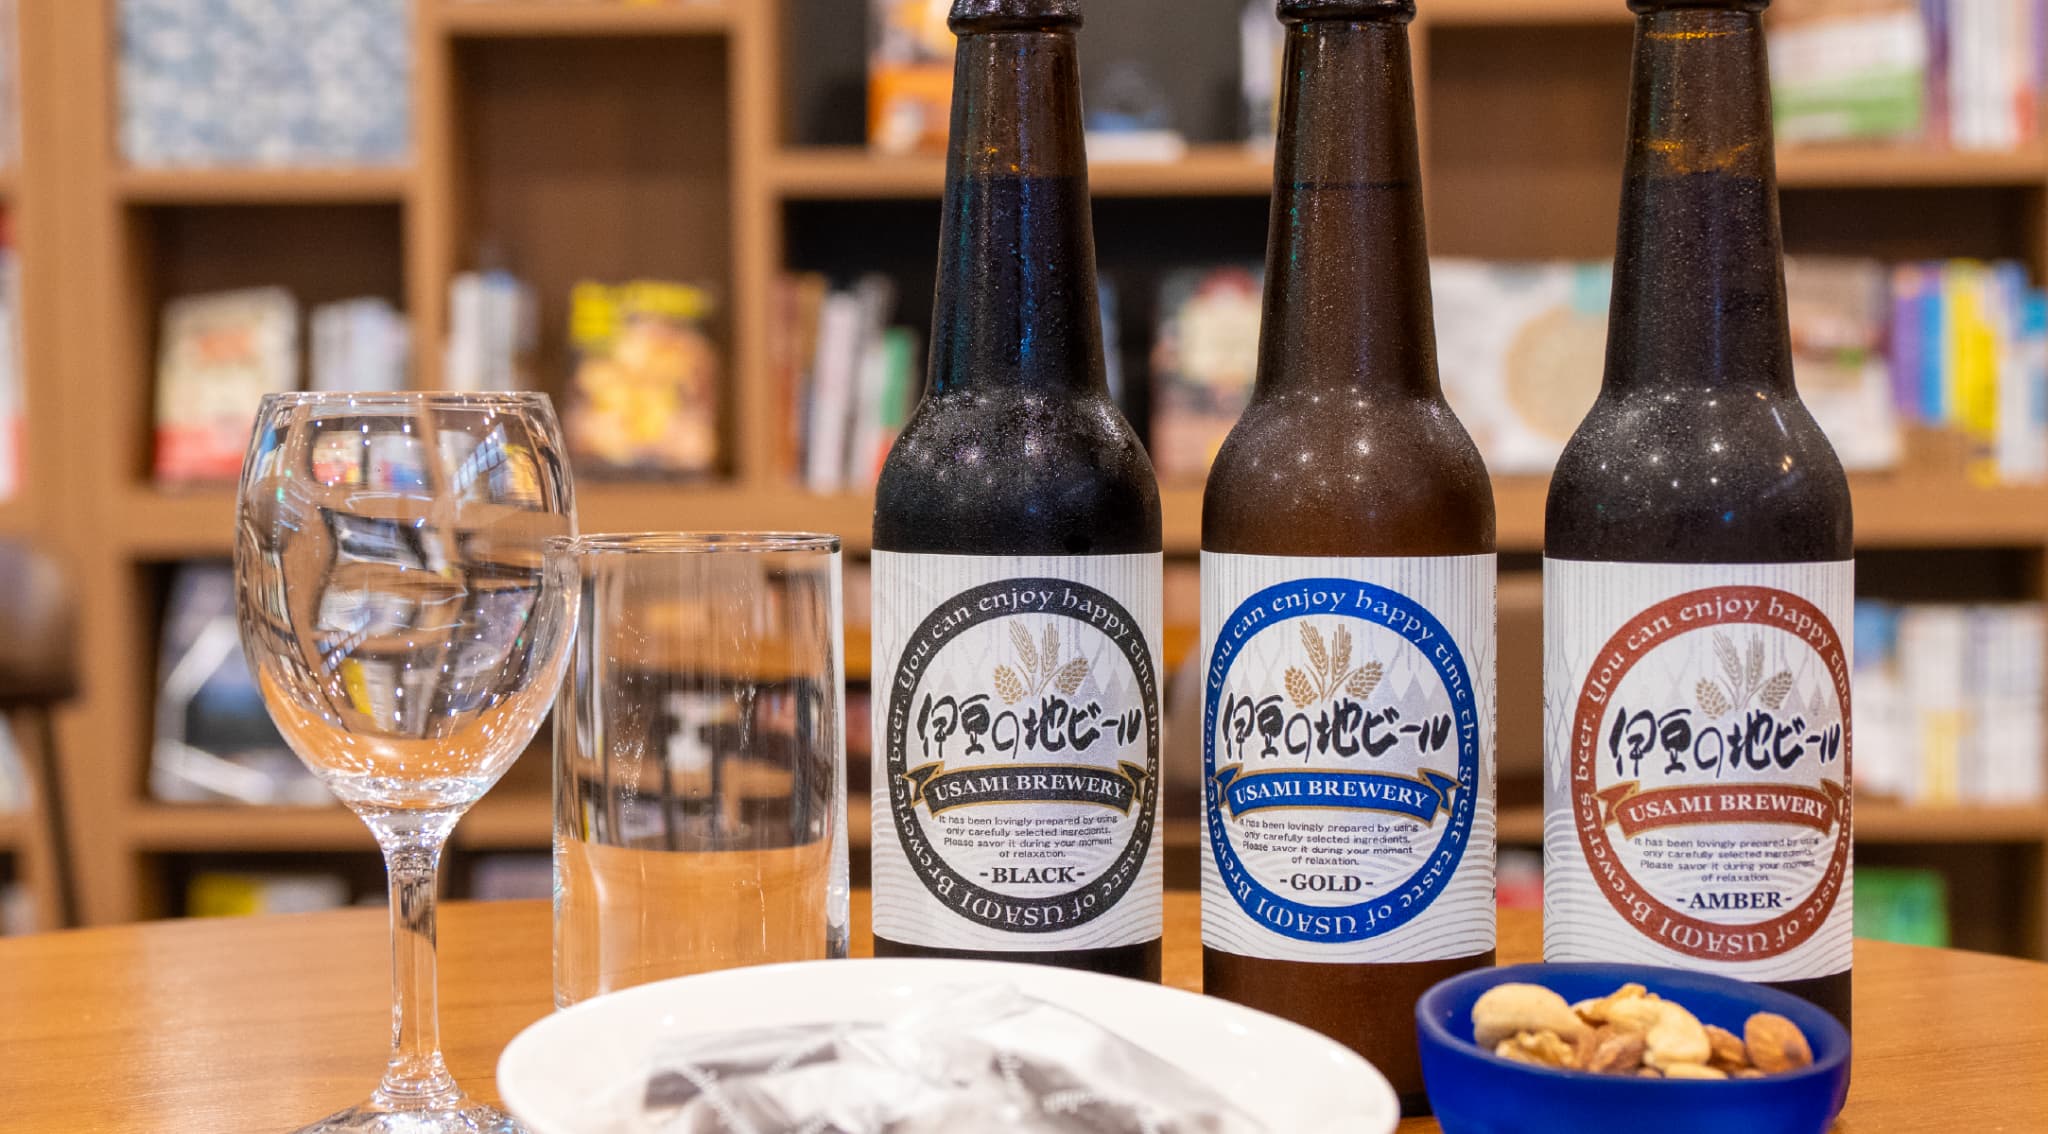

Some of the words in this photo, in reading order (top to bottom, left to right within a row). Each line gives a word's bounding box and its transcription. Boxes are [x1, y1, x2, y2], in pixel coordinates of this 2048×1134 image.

[978, 588, 1054, 611] enjoy
[1062, 588, 1130, 639] happy
[1272, 588, 1346, 612] enjoy
[1355, 589, 1434, 643] happy
[1679, 596, 1759, 622] enjoy
[932, 606, 972, 640] can
[1233, 605, 1266, 639] can
[1627, 614, 1673, 651] can
[1768, 596, 1832, 650] happy
[899, 640, 930, 691] You
[1130, 638, 1152, 696] time
[1209, 640, 1232, 690] You
[1435, 643, 1466, 701] time
[1586, 651, 1625, 705] You
[916, 692, 1143, 760] 伊豆の地ビール
[1222, 692, 1452, 763] 伊豆の地ビール
[1461, 708, 1475, 755] the
[1609, 707, 1840, 778] 伊豆の地ビール
[1576, 713, 1596, 781] beer.
[934, 775, 1010, 801] USAMI
[1015, 774, 1126, 799] BREWERY
[1235, 780, 1301, 805] USAMI
[1307, 780, 1429, 809] BREWERY
[1451, 765, 1472, 844] great
[939, 815, 946, 823] It
[948, 816, 965, 824] has
[968, 817, 991, 825] been
[995, 817, 1033, 827] lovingly
[1036, 816, 1080, 826] prepared
[1082, 816, 1094, 825] by
[1628, 795, 1713, 822] USAMI
[1719, 794, 1828, 820] BREWERY
[894, 773, 958, 898] Breweries
[944, 837, 974, 847] Please
[978, 839, 1005, 847] savor
[1009, 839, 1015, 847] it
[1020, 838, 1050, 848] during
[1054, 839, 1075, 848] your
[1078, 838, 1112, 846] moment
[946, 827, 965, 836] only
[969, 827, 1011, 837] carefully
[1015, 827, 1057, 836] selected
[1245, 820, 1260, 828] has
[1262, 821, 1284, 830] been
[1288, 822, 1324, 832] lovingly
[1328, 824, 1374, 833] prepared
[1377, 824, 1389, 833] by
[1394, 824, 1419, 832] using
[1245, 831, 1260, 840] only
[1263, 832, 1303, 842] carefully
[1306, 834, 1350, 843] selected
[1354, 835, 1410, 844] ingredients.
[1645, 838, 1663, 846] has
[1667, 839, 1693, 847] been
[1697, 839, 1735, 849] lovingly
[1740, 839, 1784, 849] prepared
[1787, 838, 1797, 847] by
[1243, 841, 1268, 851] Please
[1272, 844, 1297, 852] savor
[1301, 845, 1308, 853] it
[1311, 845, 1343, 854] during
[1291, 856, 1302, 864] of
[1305, 857, 1360, 865] relaxation.
[1580, 792, 1653, 924] Breweries
[1643, 850, 1663, 858] only
[1667, 849, 1714, 859] carefully
[1718, 850, 1762, 858] selected
[1102, 839, 1144, 897] taste
[1400, 850, 1452, 909] taste
[1640, 860, 1673, 869] Please
[1679, 862, 1706, 870] savor
[1711, 862, 1719, 870] it
[1724, 862, 1754, 871] during
[1759, 862, 1779, 871] your
[1701, 873, 1713, 881] of
[1071, 892, 1096, 920] of
[1366, 904, 1392, 931] of
[1776, 919, 1800, 948] of
